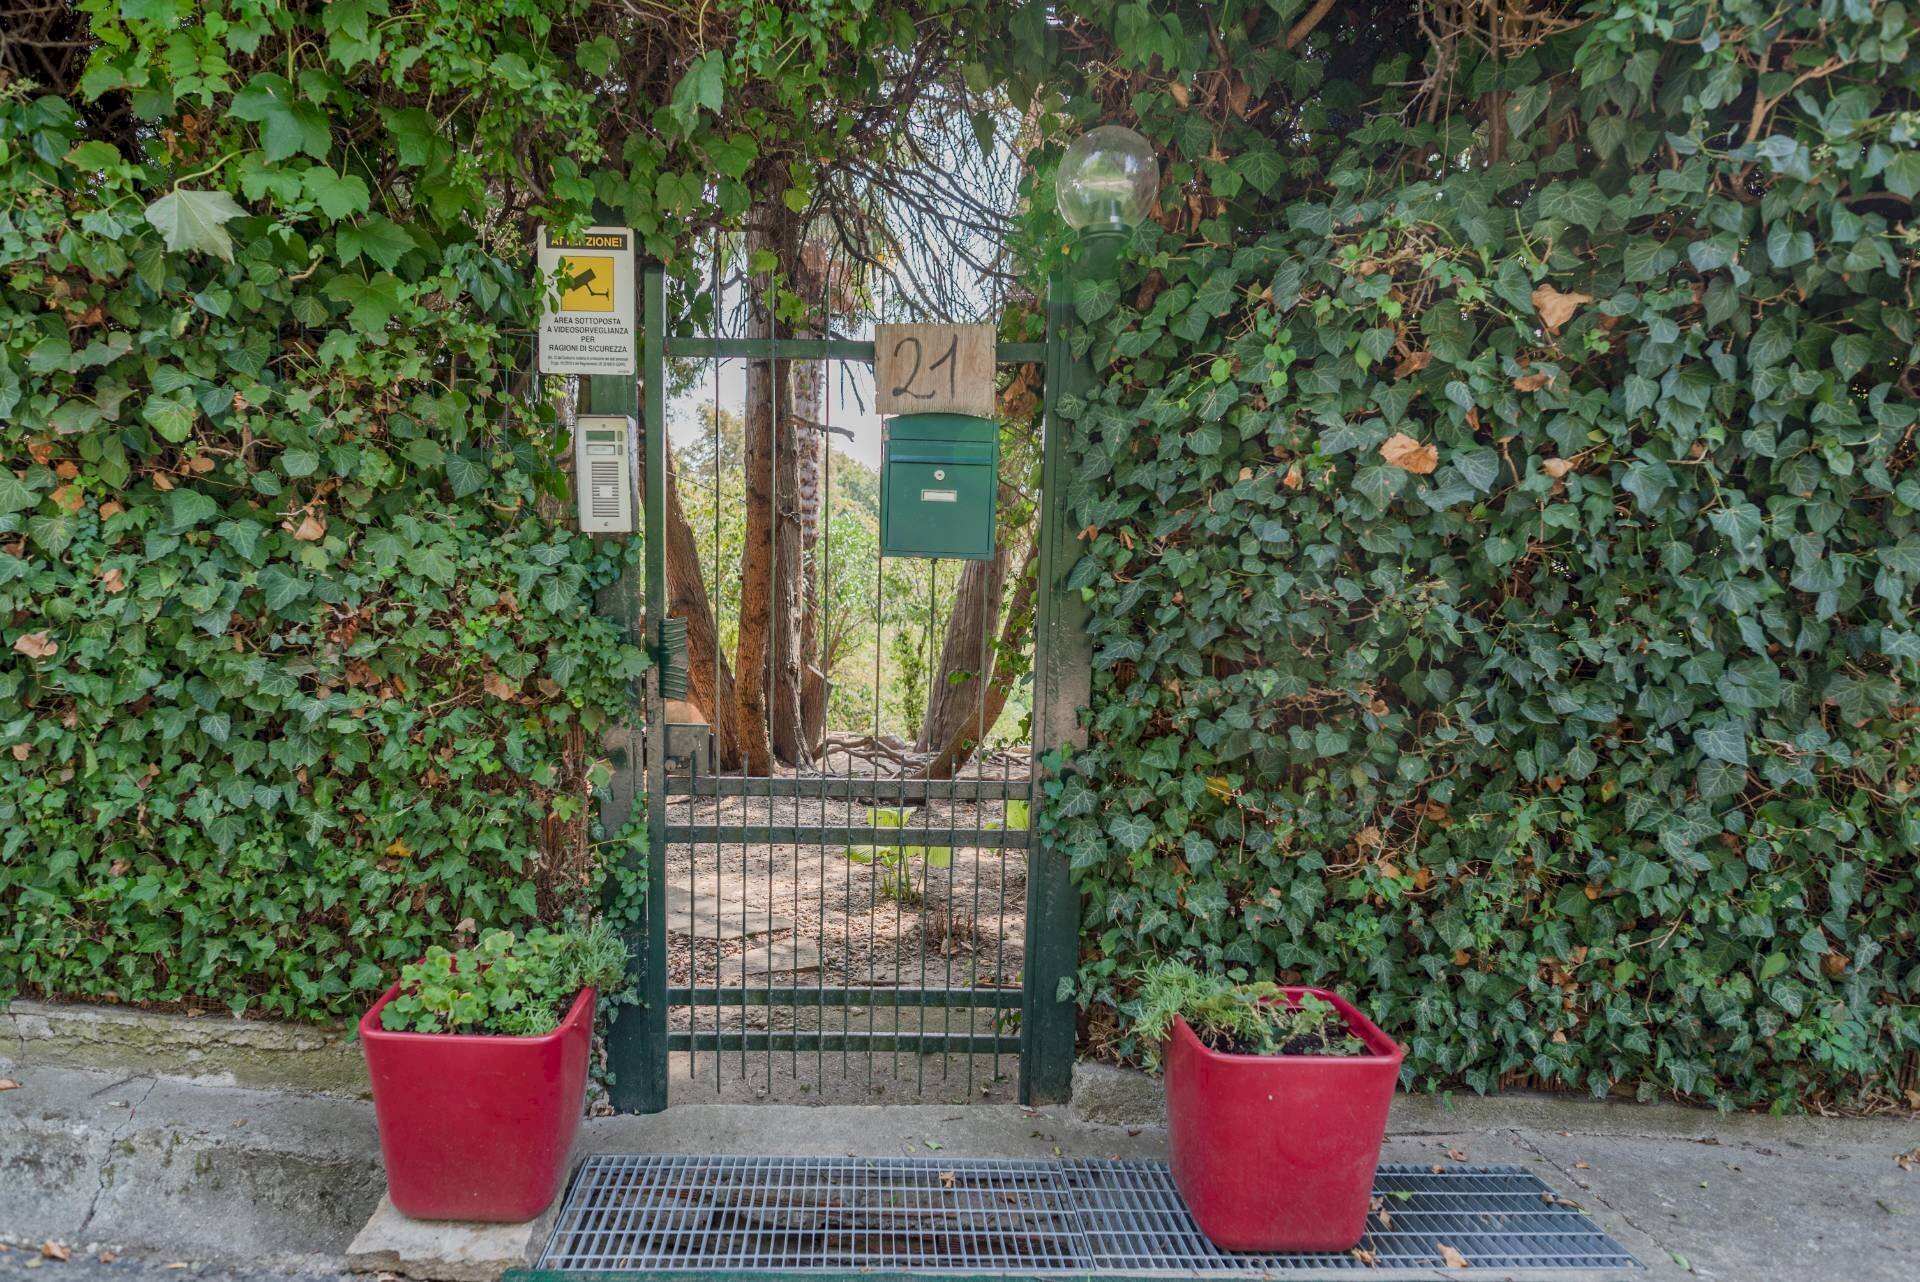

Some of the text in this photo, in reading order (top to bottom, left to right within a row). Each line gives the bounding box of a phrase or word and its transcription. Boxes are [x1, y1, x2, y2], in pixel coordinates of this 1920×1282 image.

[551, 235, 622, 248] ATZIONE!
[553, 317, 621, 325] AREA SOTTOPOSTA
[553, 326, 629, 335] VIDEOSORVEGLIANZA
[580, 335, 595, 343] PER
[549, 344, 627, 353] RAGIONI DI SICUREZZA
[892, 333, 958, 399] 21
